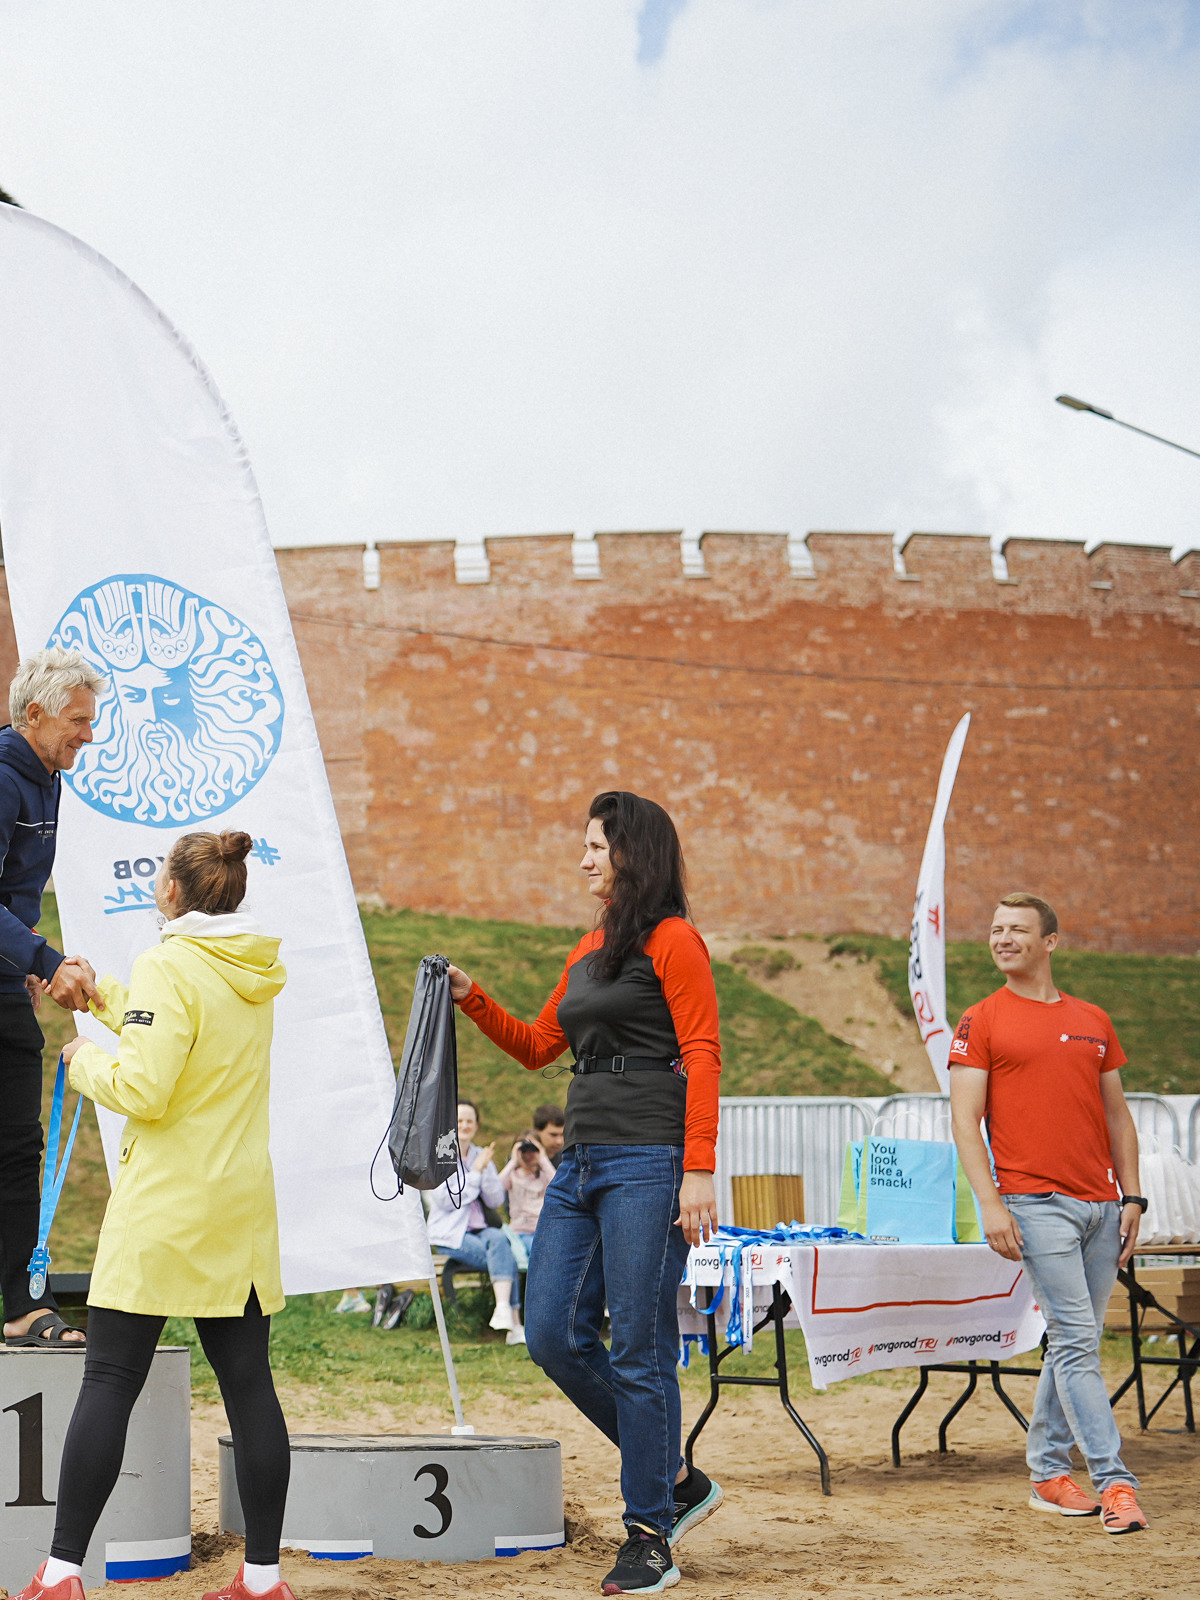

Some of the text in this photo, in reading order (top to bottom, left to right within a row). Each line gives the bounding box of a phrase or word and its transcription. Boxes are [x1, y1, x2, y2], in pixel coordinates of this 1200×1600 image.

[871, 1142, 896, 1155] You
[871, 1153, 897, 1166] look
[871, 1164, 903, 1177] like a
[871, 1177, 912, 1189] snack!
[2, 1392, 56, 1507] 1
[413, 1463, 452, 1538] 3
